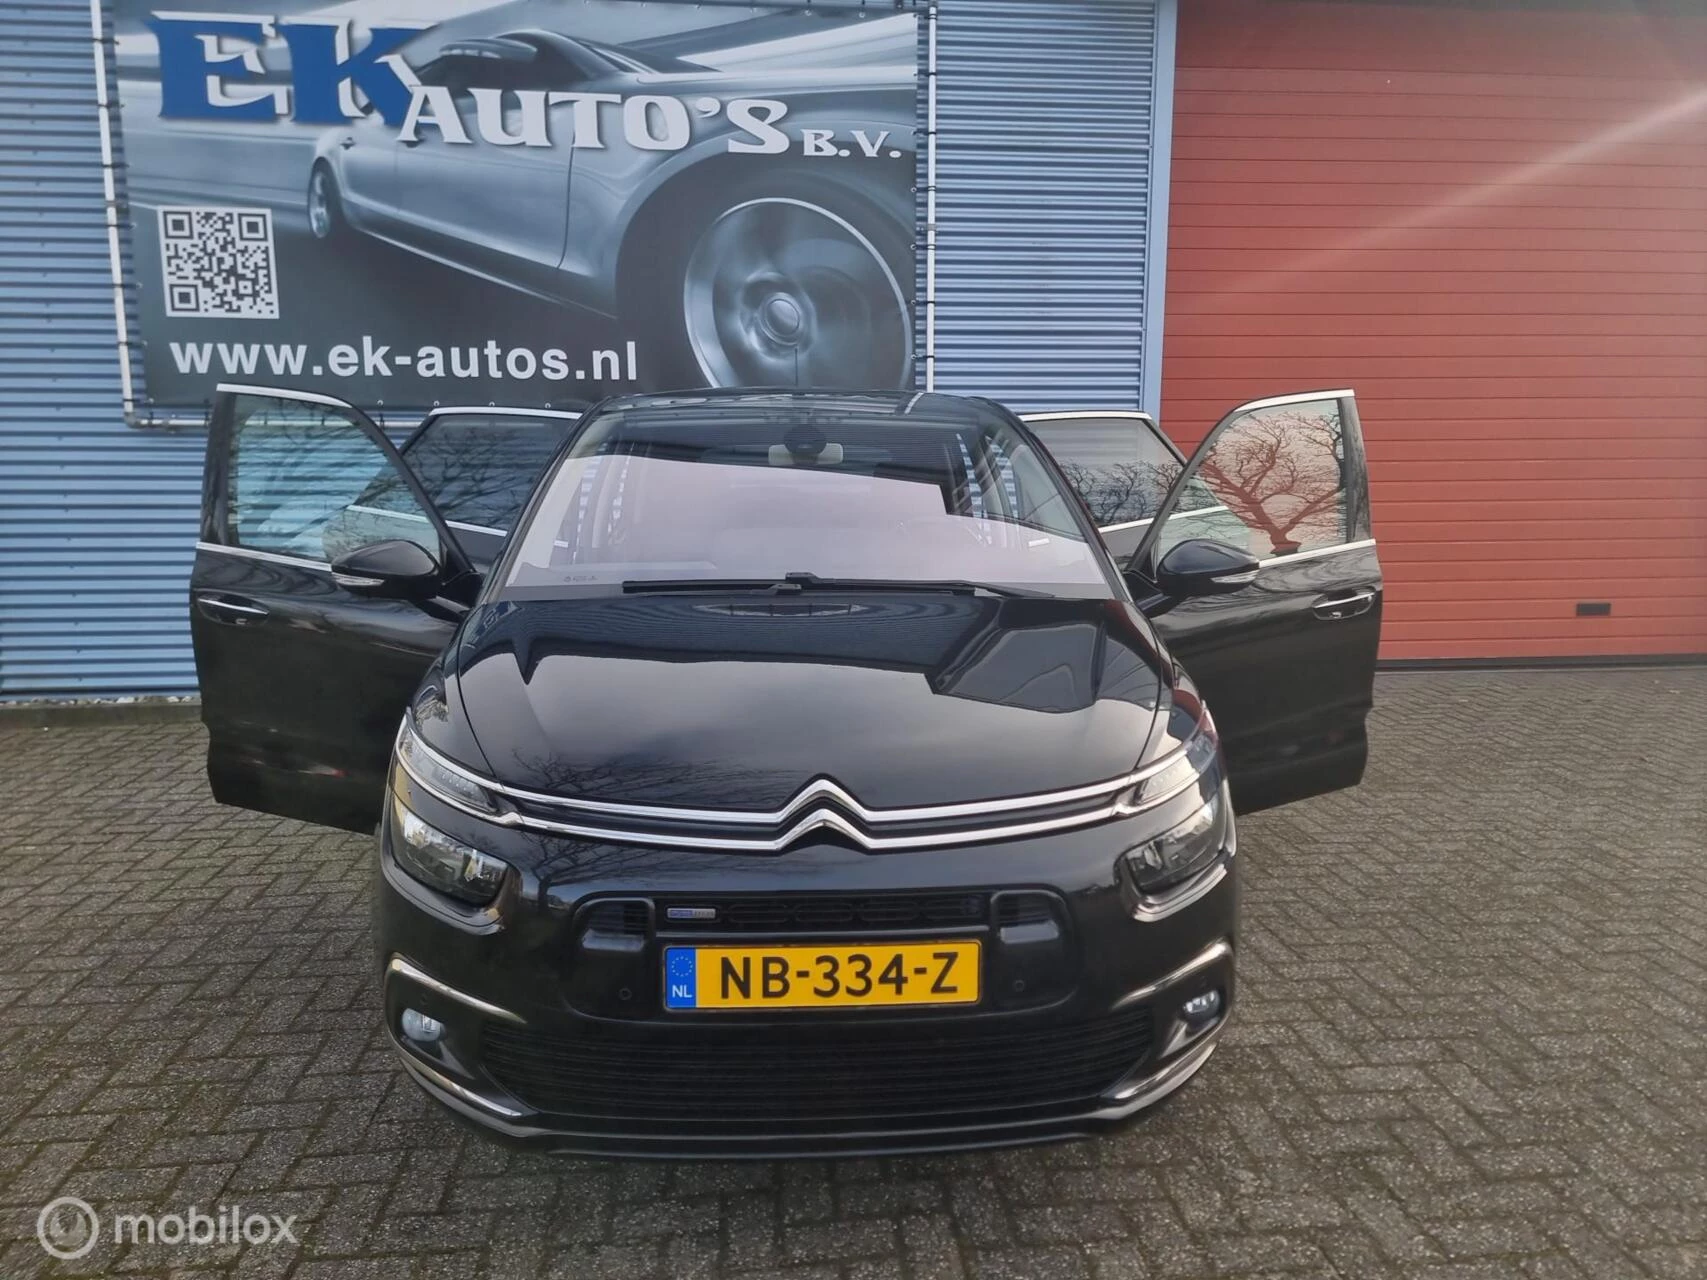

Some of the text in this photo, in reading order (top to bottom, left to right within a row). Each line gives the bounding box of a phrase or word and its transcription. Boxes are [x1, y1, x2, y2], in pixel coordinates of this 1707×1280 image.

[148, 12, 903, 159] EK AUTO'S B.V.
[170, 336, 637, 381] www.ek-autos.nl
[672, 984, 692, 998] NL
[720, 951, 959, 999] NB-334-Z
